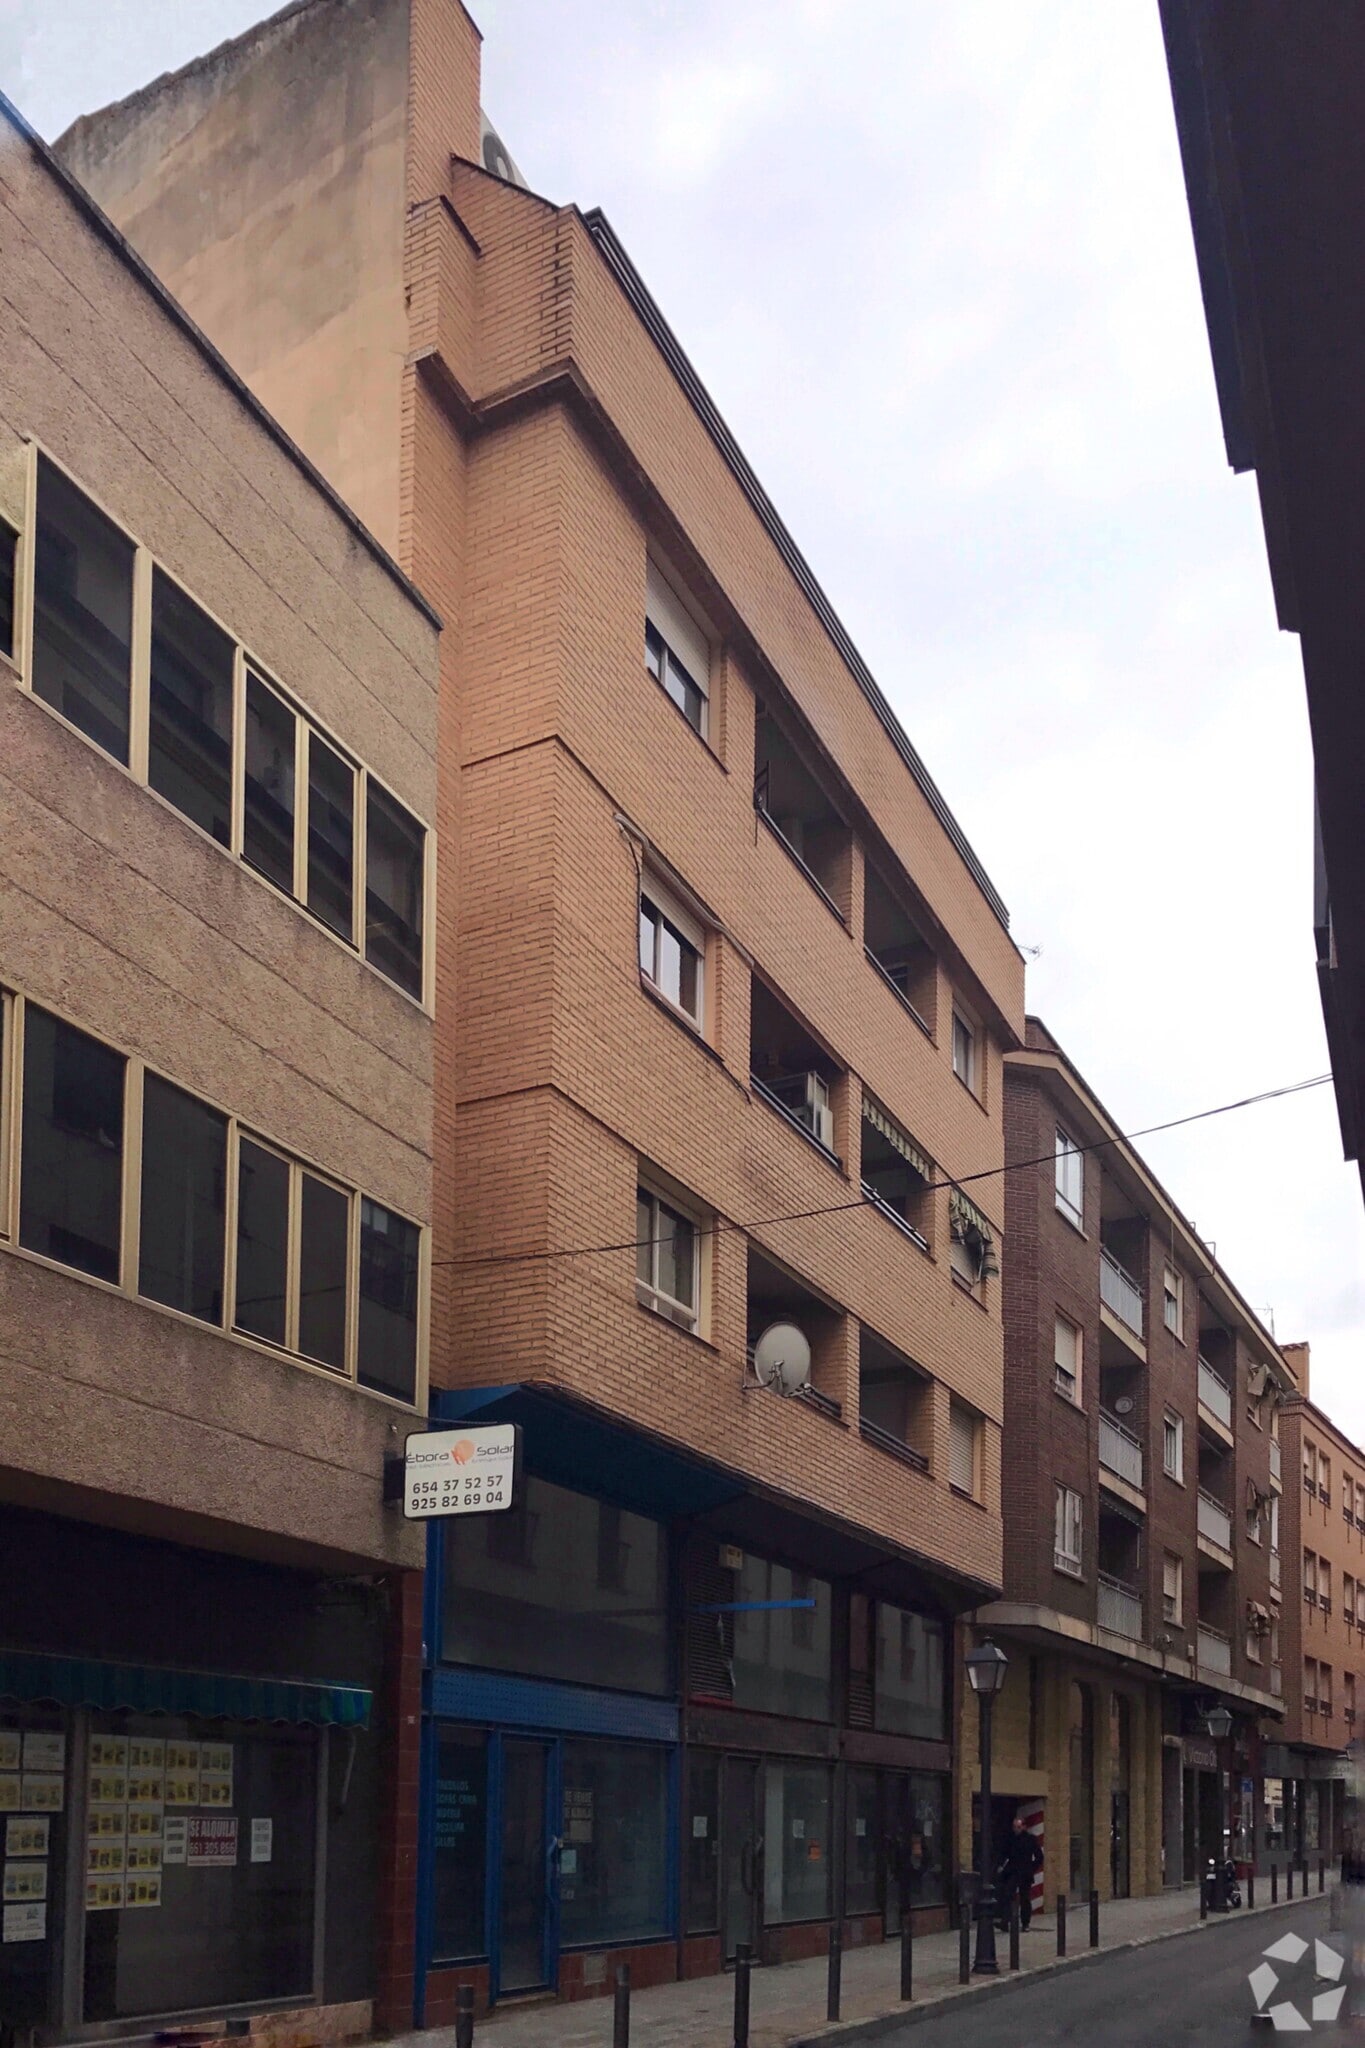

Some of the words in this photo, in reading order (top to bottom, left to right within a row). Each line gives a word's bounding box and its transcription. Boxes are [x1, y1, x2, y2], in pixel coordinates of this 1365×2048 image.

[476, 1445, 514, 1456] Solar
[412, 1481, 438, 1494] 654
[443, 1479, 459, 1491] 37
[464, 1477, 481, 1489] 52
[486, 1475, 503, 1487] 57
[411, 1497, 437, 1510] 925
[441, 1495, 459, 1508] 82
[463, 1493, 481, 1506] 69
[485, 1491, 503, 1503] 04
[190, 1820, 200, 1837] SE
[200, 1820, 235, 1838] ALQUILA
